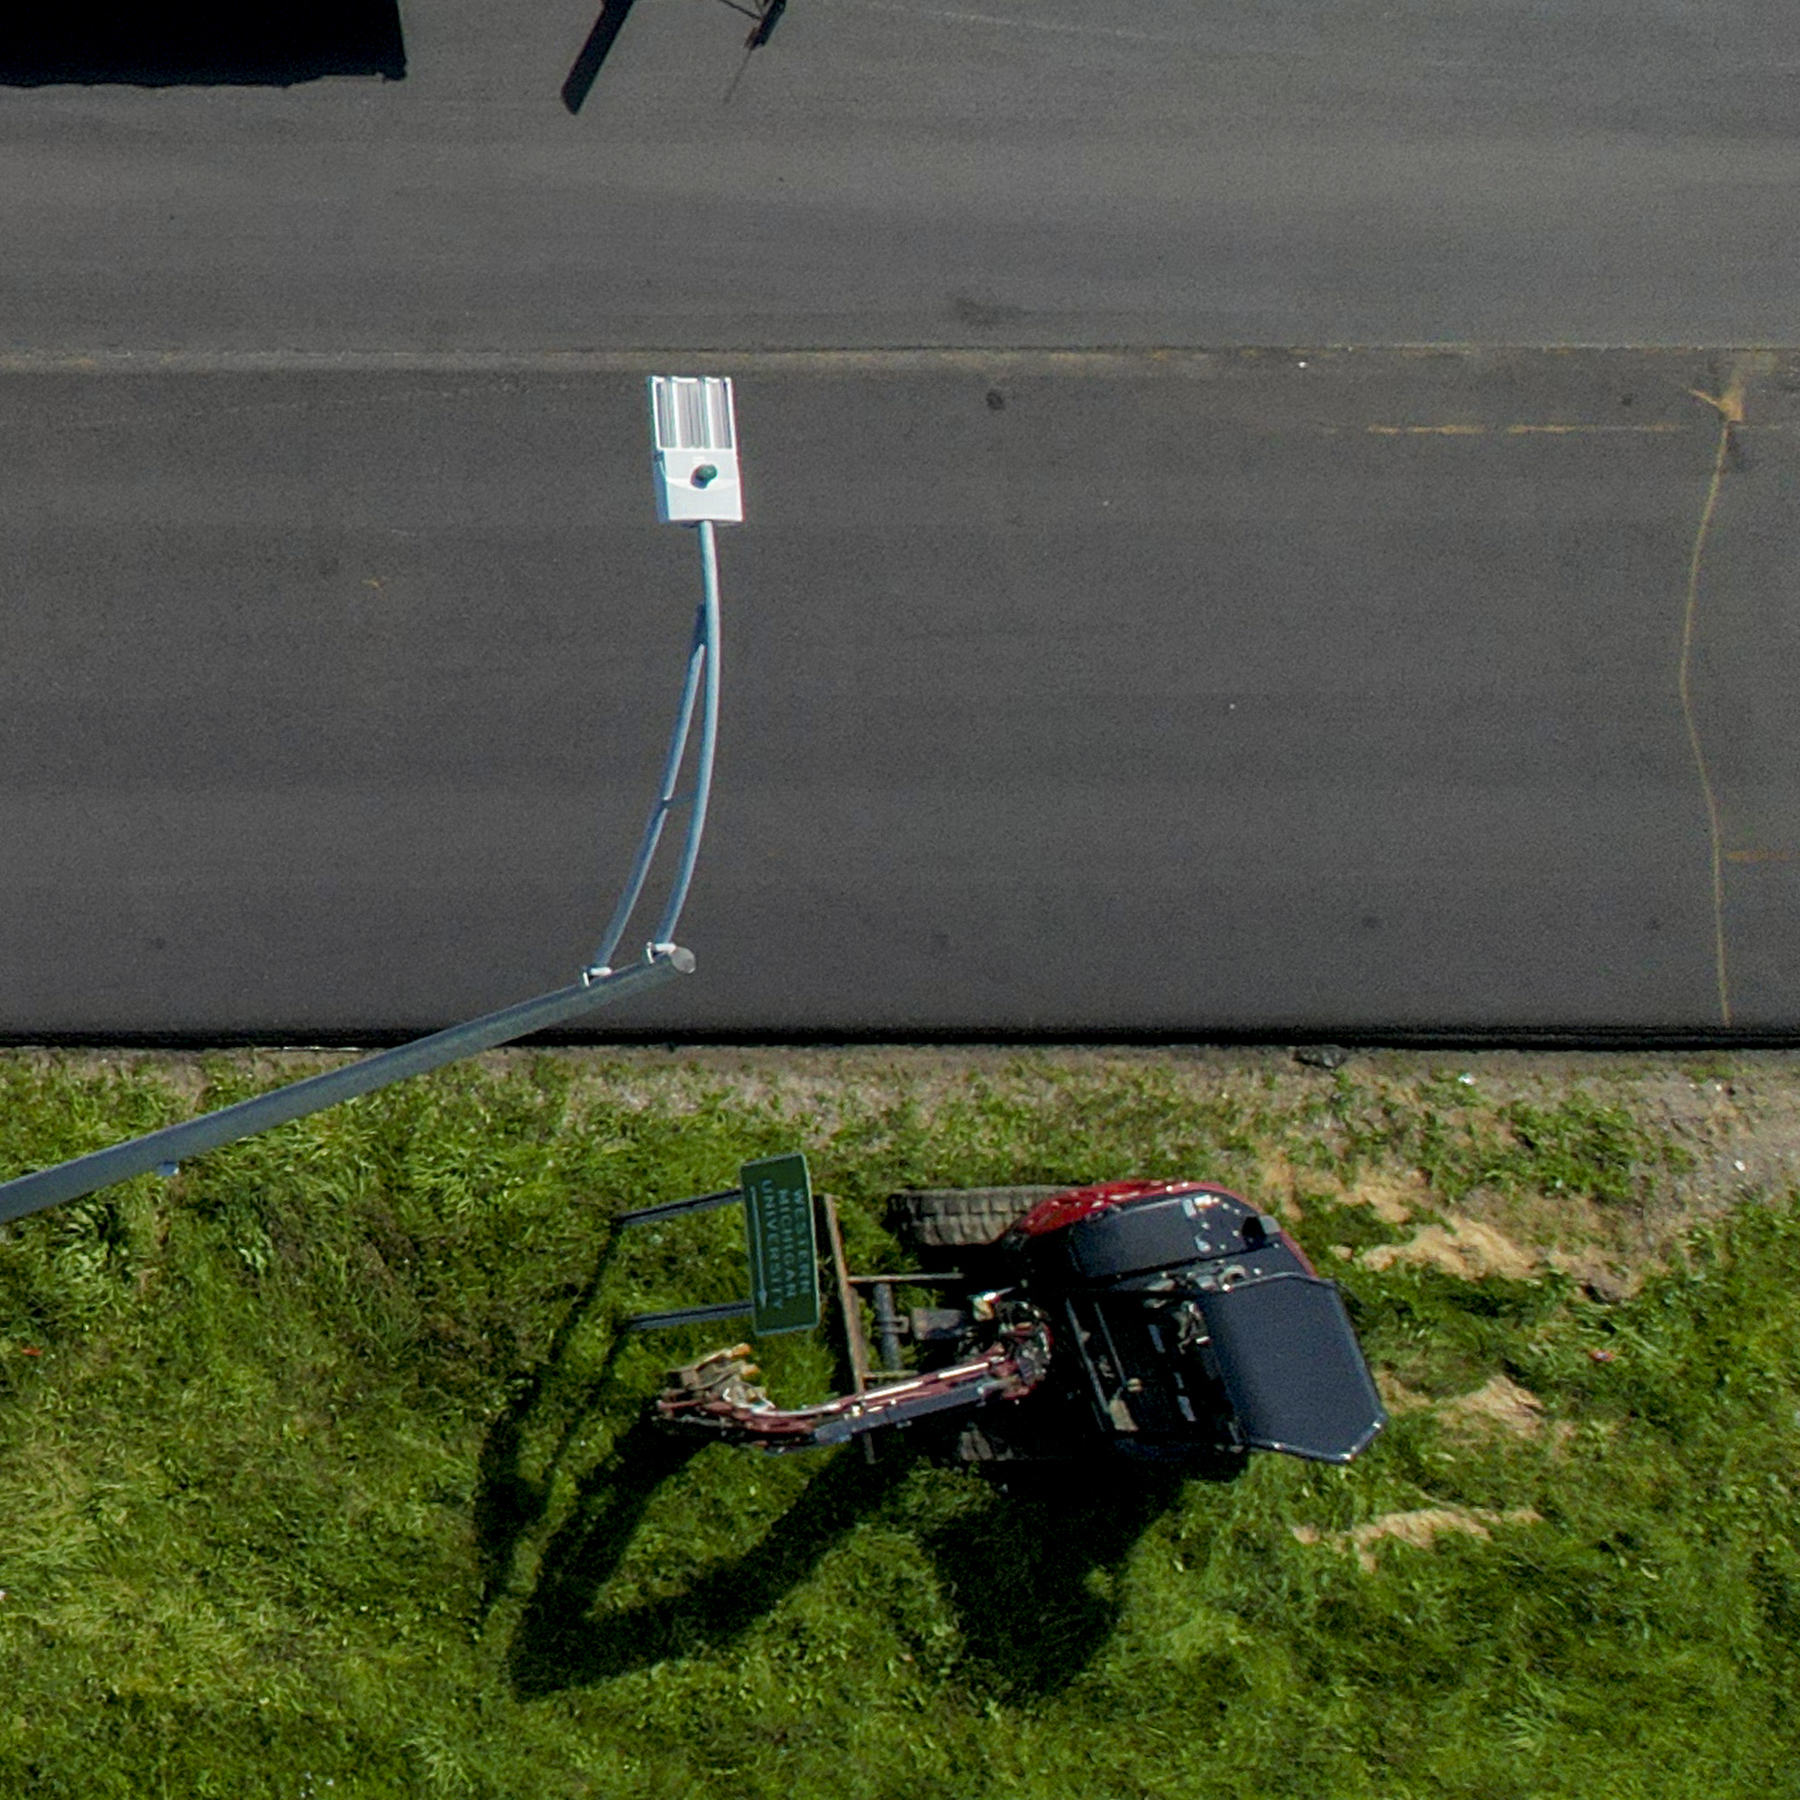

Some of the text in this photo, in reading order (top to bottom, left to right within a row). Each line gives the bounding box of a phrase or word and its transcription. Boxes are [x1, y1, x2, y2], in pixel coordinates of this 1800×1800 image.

[762, 1179, 783, 1309] UNIVERSITY
[778, 1189, 796, 1298] MICHIGAN
[794, 1187, 810, 1294] WESTERN
